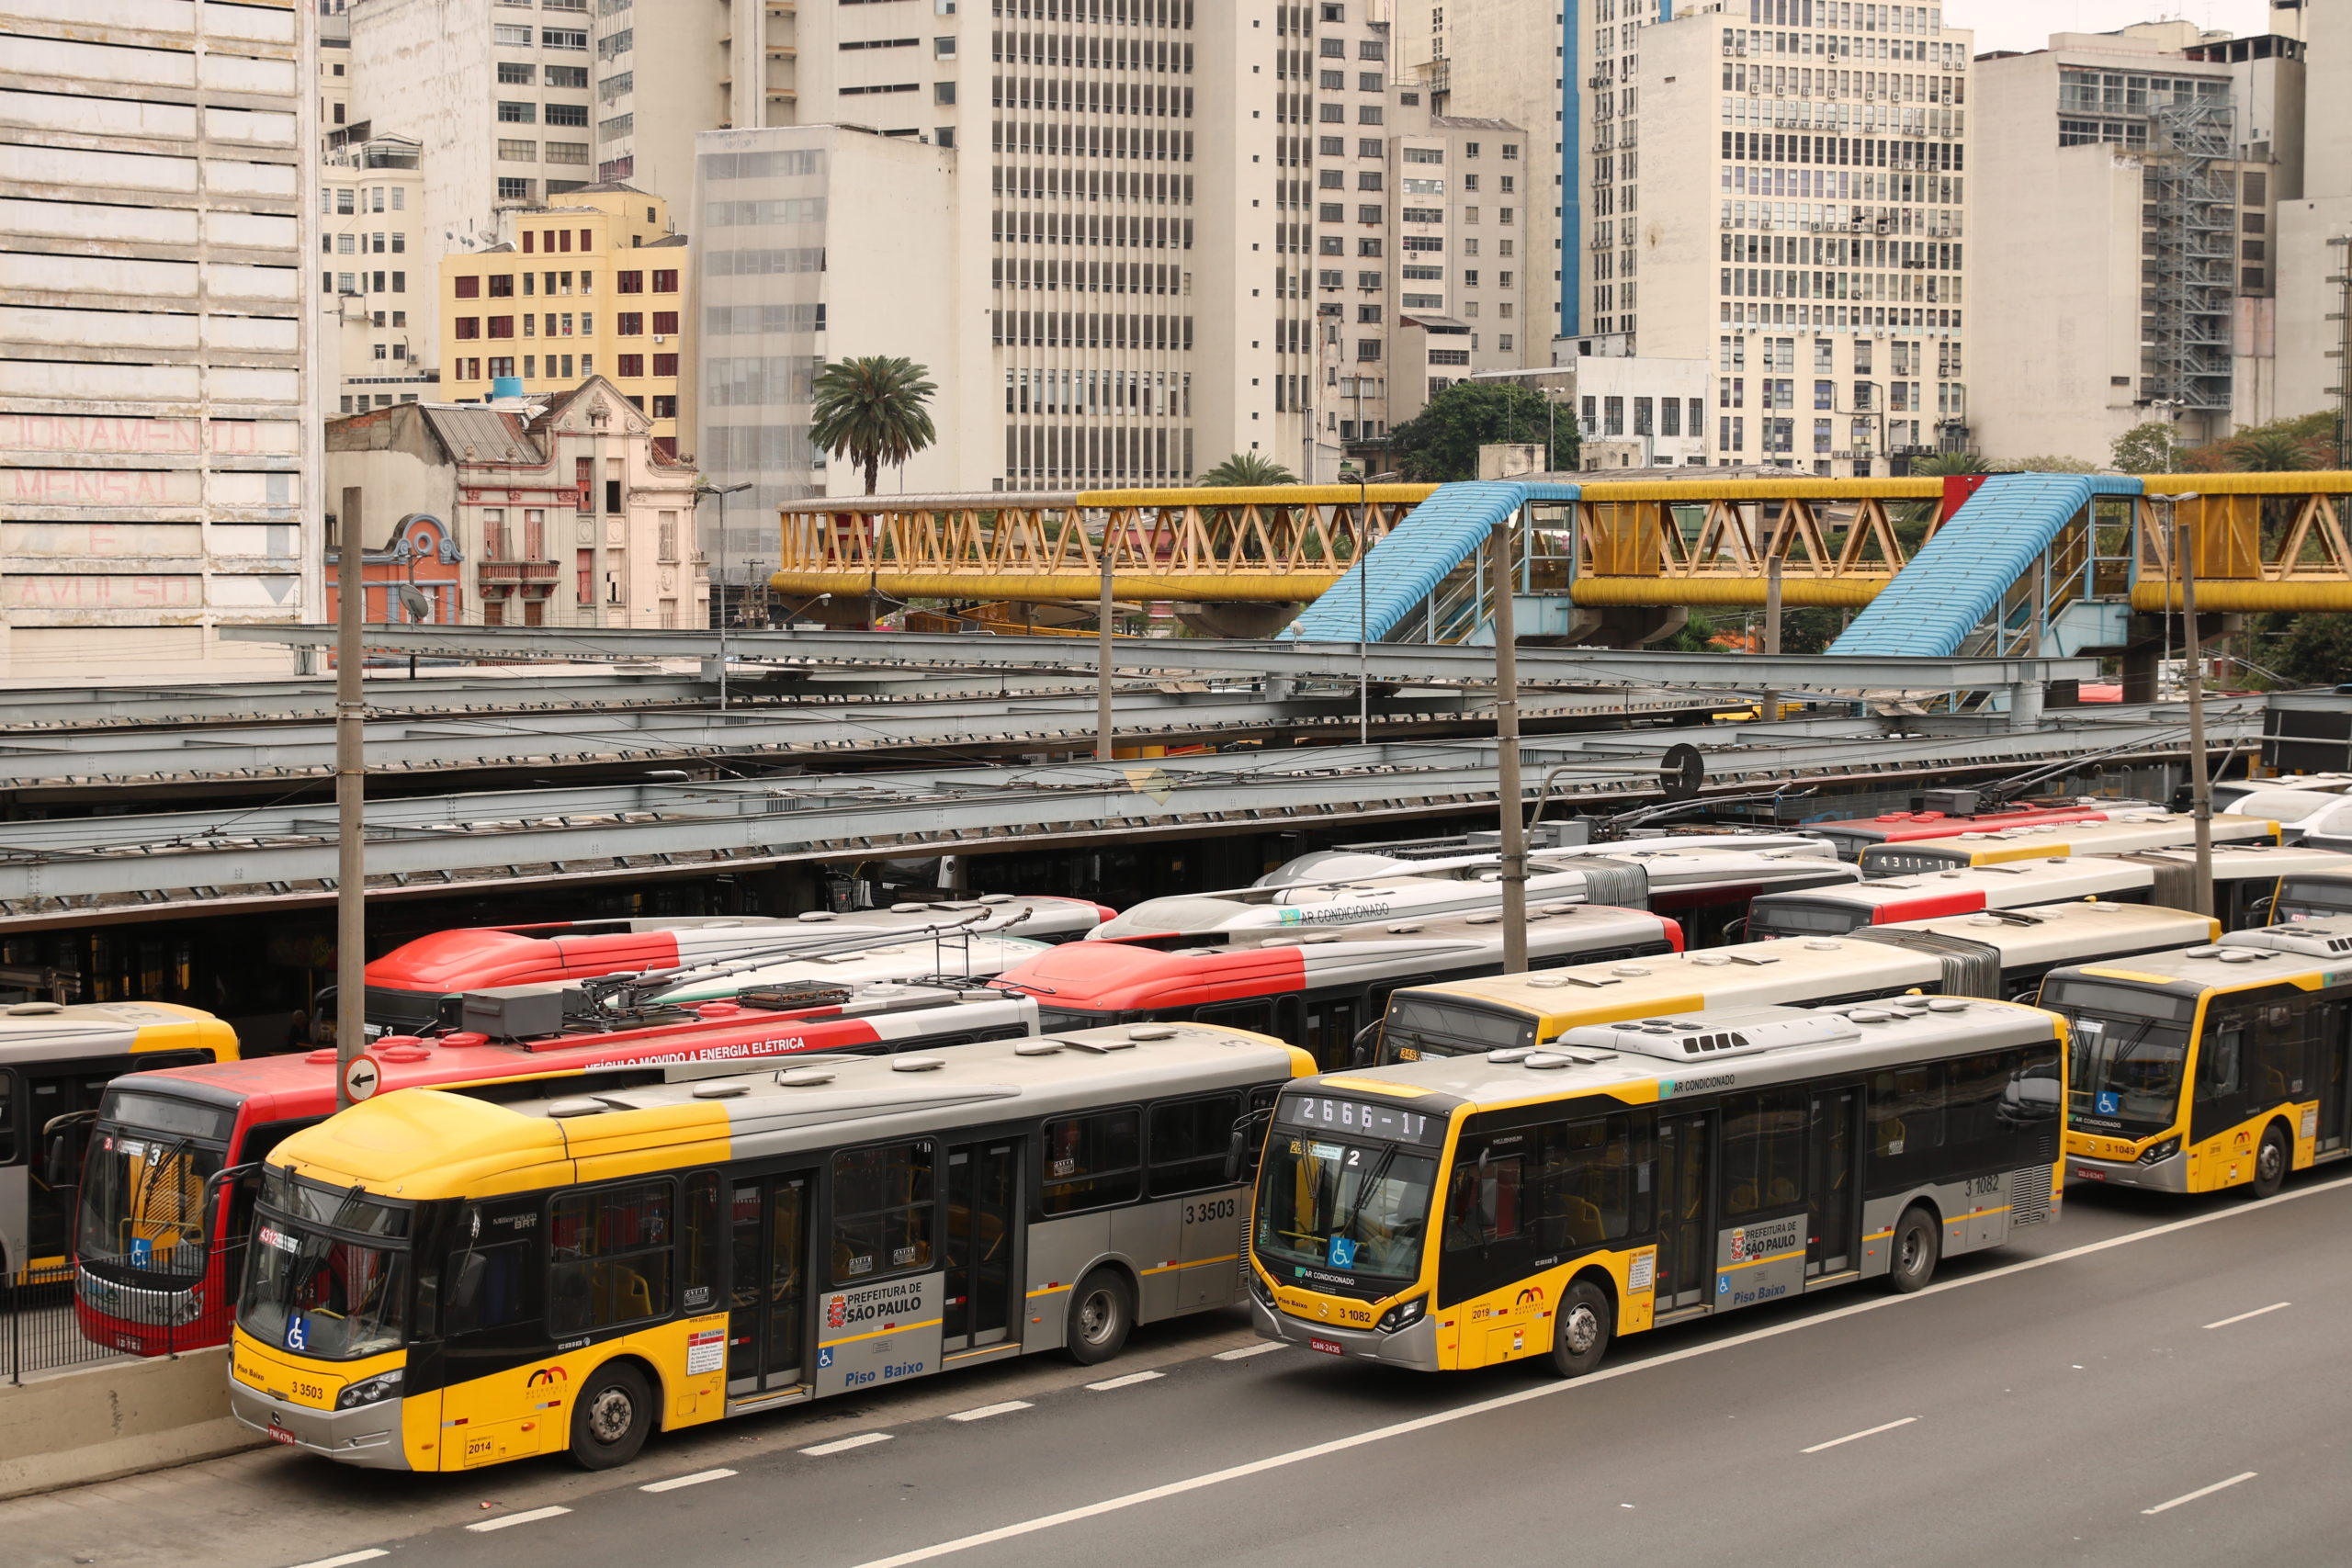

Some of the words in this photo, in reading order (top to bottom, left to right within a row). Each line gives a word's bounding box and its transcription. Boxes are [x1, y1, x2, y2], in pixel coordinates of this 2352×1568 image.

[15, 469, 169, 505] MENSAL
[88, 525, 118, 557] E
[18, 575, 188, 607] AVULSO
[1301, 911, 1315, 925] AR
[1317, 902, 1389, 922] CONDICIONADO
[700, 1043, 749, 1062] ENERGIA
[752, 1036, 805, 1055] ELÉTRICA
[1673, 1082, 1684, 1094] AR
[1685, 1074, 1736, 1092] CONDICIONADO
[2084, 1117, 2121, 1128] CONDICIONADO
[149, 1148, 161, 1167] 3
[1347, 1150, 1361, 1167] 2
[2106, 1144, 2111, 1152] 3
[2114, 1145, 2136, 1156] 1049
[1965, 1180, 1972, 1197] 3
[1975, 1175, 1999, 1194] 1082
[1185, 1205, 1194, 1224] 3
[1198, 1198, 1234, 1223] 3503
[514, 1218, 537, 1230] BRT
[1746, 1224, 1786, 1240] PREFEITURA
[1787, 1221, 1796, 1231] DE
[260, 1228, 278, 1245] 4312
[1746, 1239, 1764, 1256] SÃO
[1766, 1234, 1795, 1251] PAULO
[1313, 1272, 1355, 1285] CONDICIONADO
[847, 1283, 906, 1305] PREFEITURA
[910, 1282, 922, 1292] DE
[1278, 1297, 1290, 1306] Piso
[1291, 1300, 1308, 1309] Baixo
[1734, 1292, 1755, 1304] Piso
[1758, 1284, 1786, 1299] Baixo
[847, 1304, 875, 1324] SÃO
[877, 1296, 922, 1317] PAULO
[1340, 1308, 1346, 1319] 3
[1349, 1310, 1371, 1323] 1082
[1473, 1308, 1489, 1319] 2019
[237, 1363, 248, 1374] Piso
[249, 1370, 265, 1382] Baixo
[845, 1370, 876, 1387] Piso
[884, 1361, 923, 1380] Baixo
[292, 1382, 298, 1393] 3
[300, 1383, 323, 1400] 3503
[469, 1442, 492, 1455] 2014
